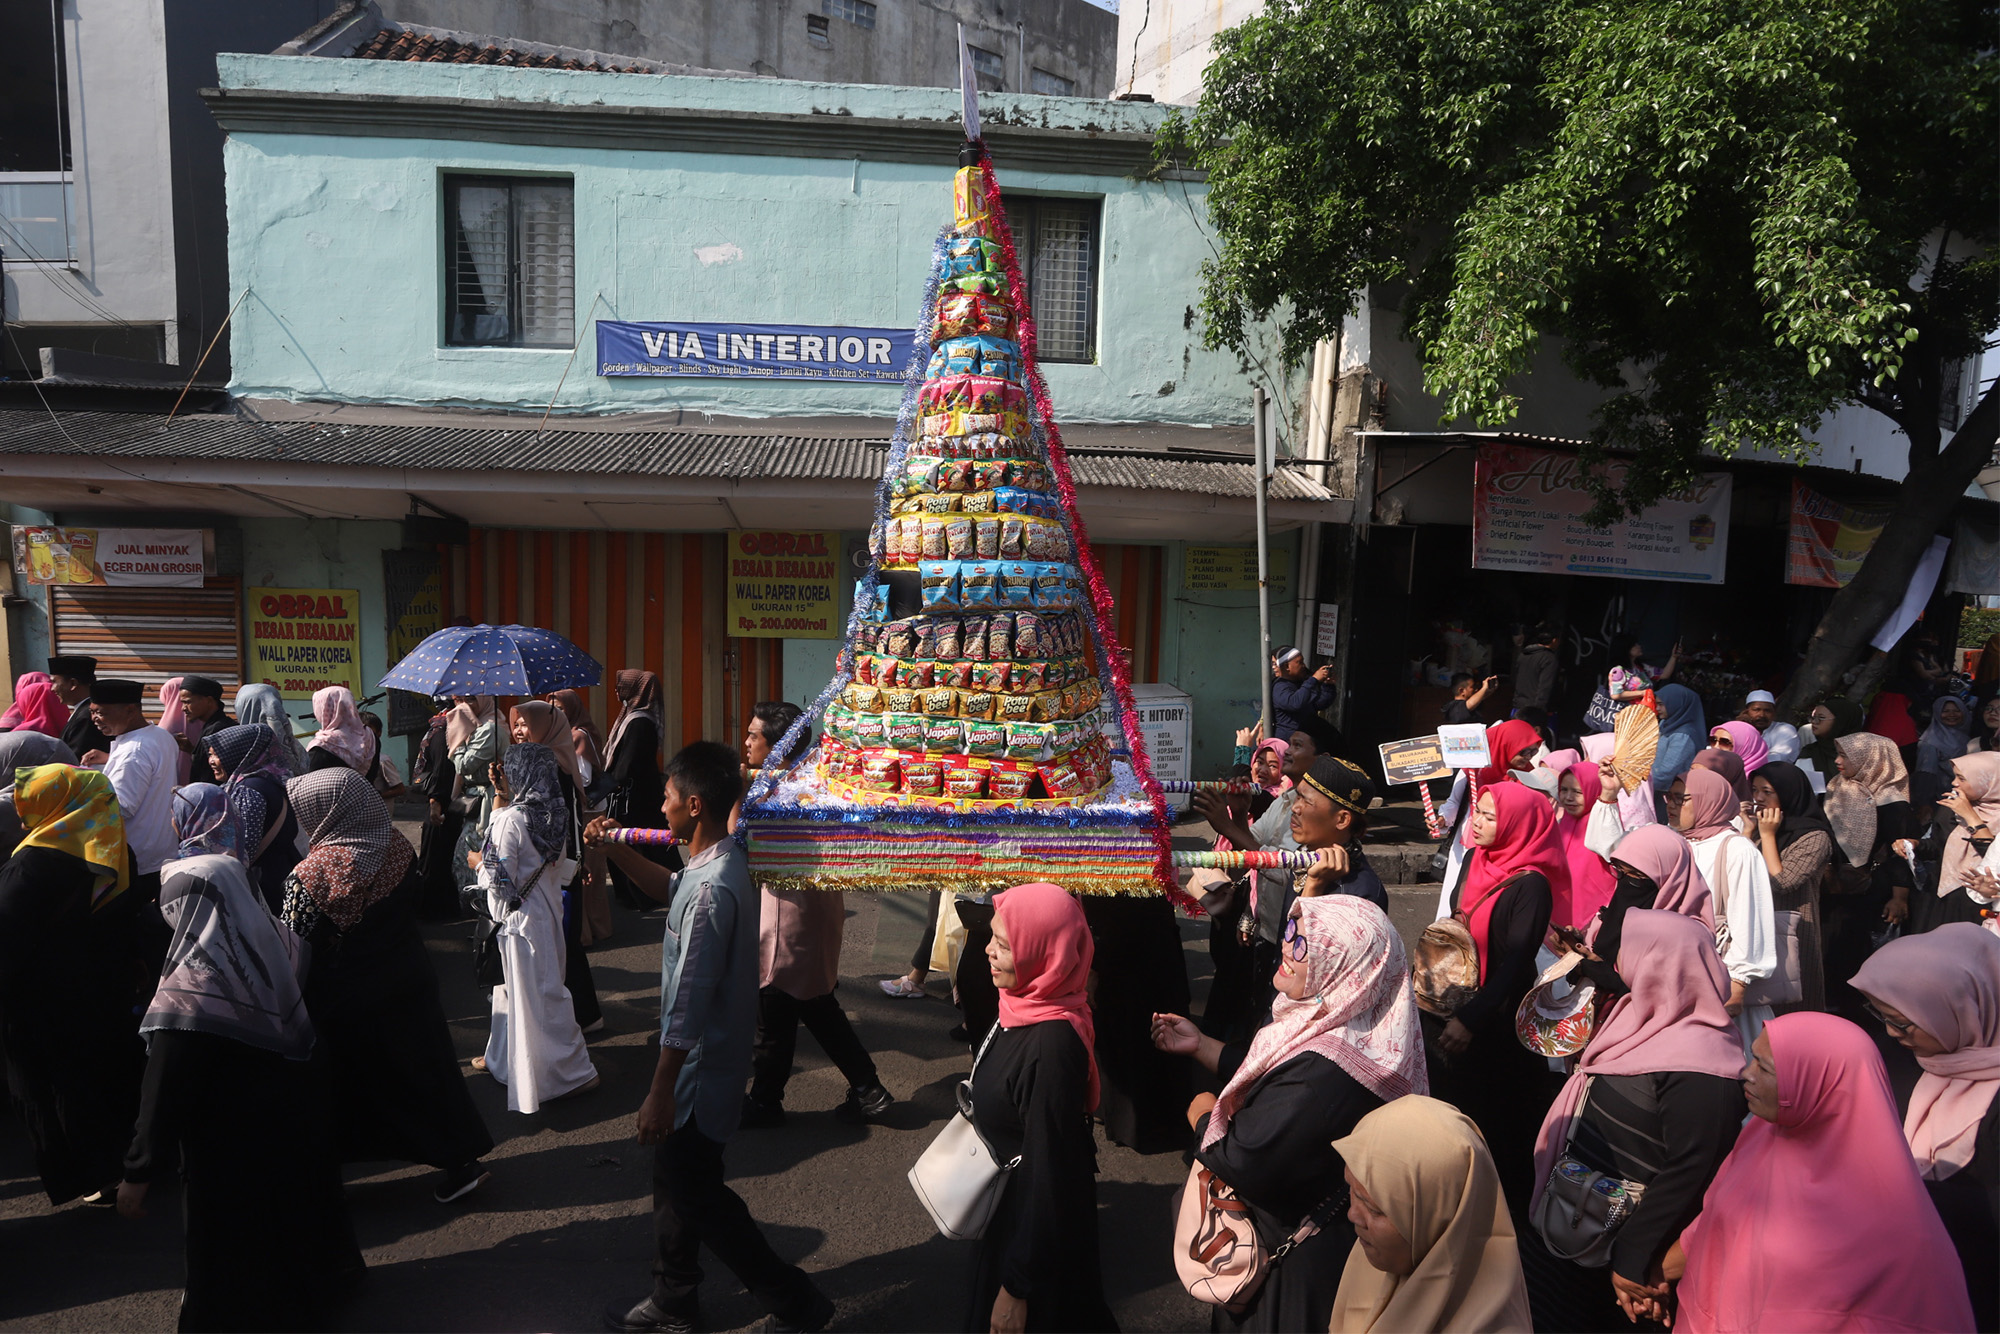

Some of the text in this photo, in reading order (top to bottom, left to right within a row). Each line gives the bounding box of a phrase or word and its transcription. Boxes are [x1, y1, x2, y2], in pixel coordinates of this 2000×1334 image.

[641, 332, 892, 364] VIA INTERIOR
[602, 362, 630, 373] Gorden
[636, 363, 673, 374] Wallpaper
[678, 363, 702, 374] Blinds
[707, 365, 721, 375] Sky
[723, 365, 742, 376] Light
[748, 366, 774, 377] Kanopi
[780, 367, 802, 376] Lantai
[804, 368, 823, 378] Kayu
[828, 368, 857, 378] Kitchen
[859, 369, 870, 378] Set
[876, 370, 898, 380] Kawat
[973, 461, 992, 469] Taro
[926, 496, 950, 507] Pota
[965, 494, 988, 506] Pota
[927, 503, 949, 513] bee
[967, 502, 987, 512] bee
[1491, 506, 1513, 517] Bunga
[1514, 508, 1536, 519] Import
[1542, 511, 1560, 520] Lokal
[1491, 519, 1545, 530] Artificial Flower
[1567, 525, 1592, 535] Bouquet
[1490, 530, 1533, 541] Dried Flower
[739, 532, 829, 557] OBRAL
[1565, 537, 1615, 549] Money Bouquet
[114, 544, 190, 556] JUAL MINYAK
[104, 562, 202, 573] ECER DAN GROSIR
[732, 559, 835, 579] BESAR BESARAN
[964, 575, 998, 589] CRUNCHY
[736, 583, 831, 601] WALL PAPER KOREA
[260, 594, 348, 619] OBRAL
[393, 600, 438, 617] Blinds
[751, 602, 792, 612] UKURAN
[795, 603, 806, 612] 15
[738, 616, 827, 631] Rp. 200.000/roll
[254, 621, 355, 641] BESAR BESARAN
[259, 645, 352, 664] WALL PAPER KOREA
[275, 665, 315, 674] UKURAN
[318, 665, 328, 674] 15
[898, 660, 916, 670] Taro
[935, 661, 954, 671] Taro
[973, 662, 993, 671] Taro
[1012, 661, 1031, 670] Taro
[888, 693, 913, 705] Pota
[926, 690, 951, 703] Pota
[966, 692, 991, 706] Pota
[1003, 693, 1029, 707] Pota
[891, 701, 910, 712] bee
[928, 699, 949, 712] bee
[968, 701, 989, 714] bee
[1006, 703, 1026, 714] bee
[1149, 708, 1184, 722] HITORY
[889, 724, 921, 739] Japota
[925, 726, 960, 741] Japota
[969, 731, 1001, 745] Japota
[1009, 734, 1044, 749] Japota
[1399, 750, 1428, 758] KELURAHAN
[990, 776, 1015, 785] French
